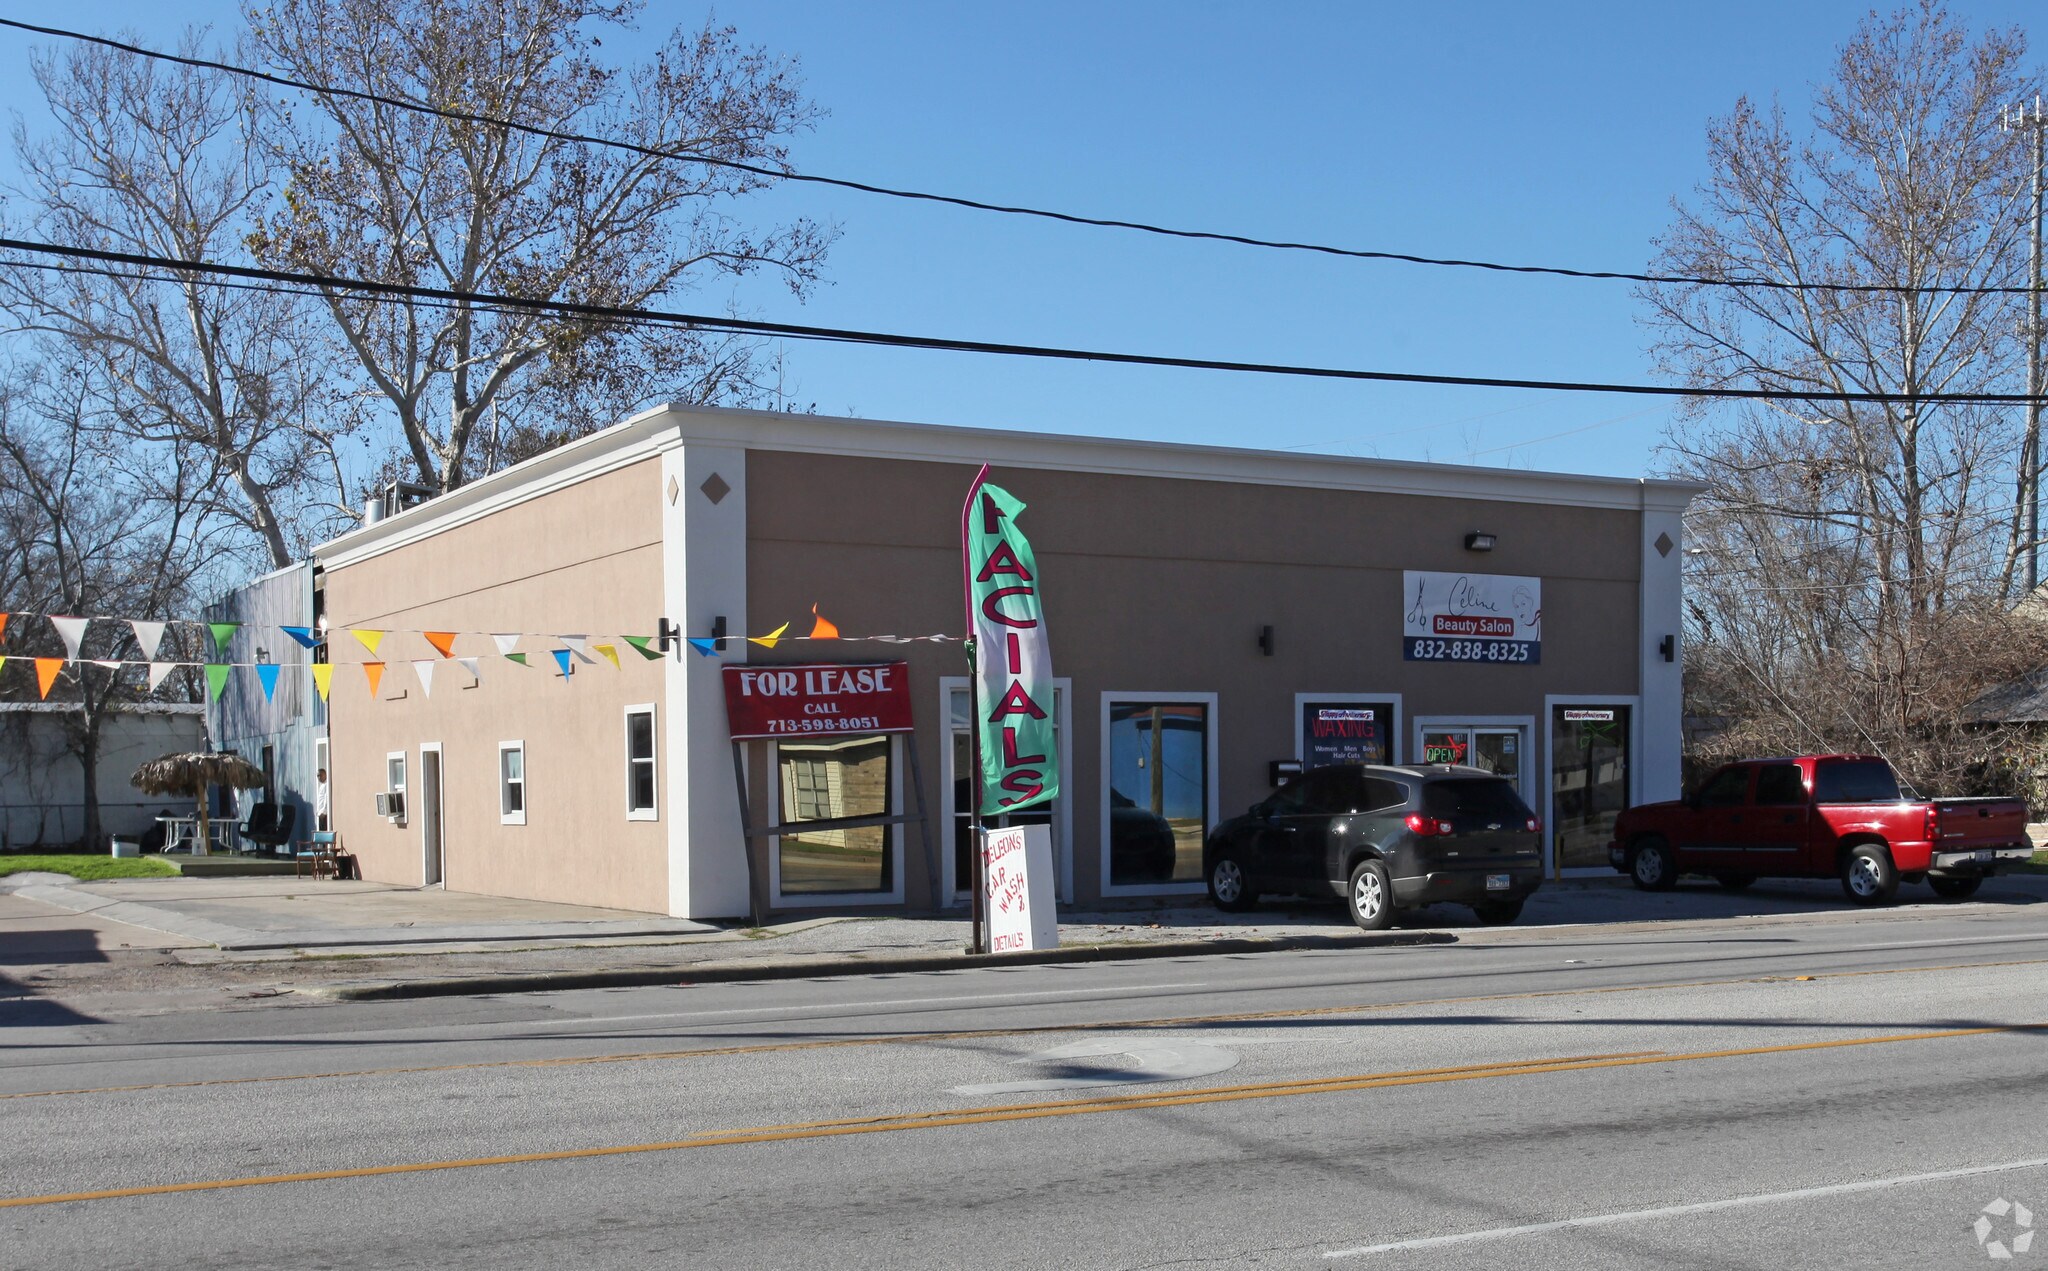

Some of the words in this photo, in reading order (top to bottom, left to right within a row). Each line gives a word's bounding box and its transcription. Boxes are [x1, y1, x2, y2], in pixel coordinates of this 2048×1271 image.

[1448, 576, 1499, 616] Celine
[1436, 618, 1478, 635] Beauty
[1480, 619, 1512, 633] Salon
[976, 492, 1048, 806] FACIALS
[1413, 640, 1529, 661] 832-838-8325
[740, 671, 798, 696] FOR
[805, 668, 892, 696] LEASE
[803, 702, 840, 715] CALL
[767, 716, 880, 732] 713-598-8051
[1363, 745, 1376, 753] Boys
[1426, 748, 1456, 762] OPEN
[985, 866, 1006, 899] CAR
[999, 872, 1025, 914] WASH
[993, 932, 1024, 951] DETAILS
